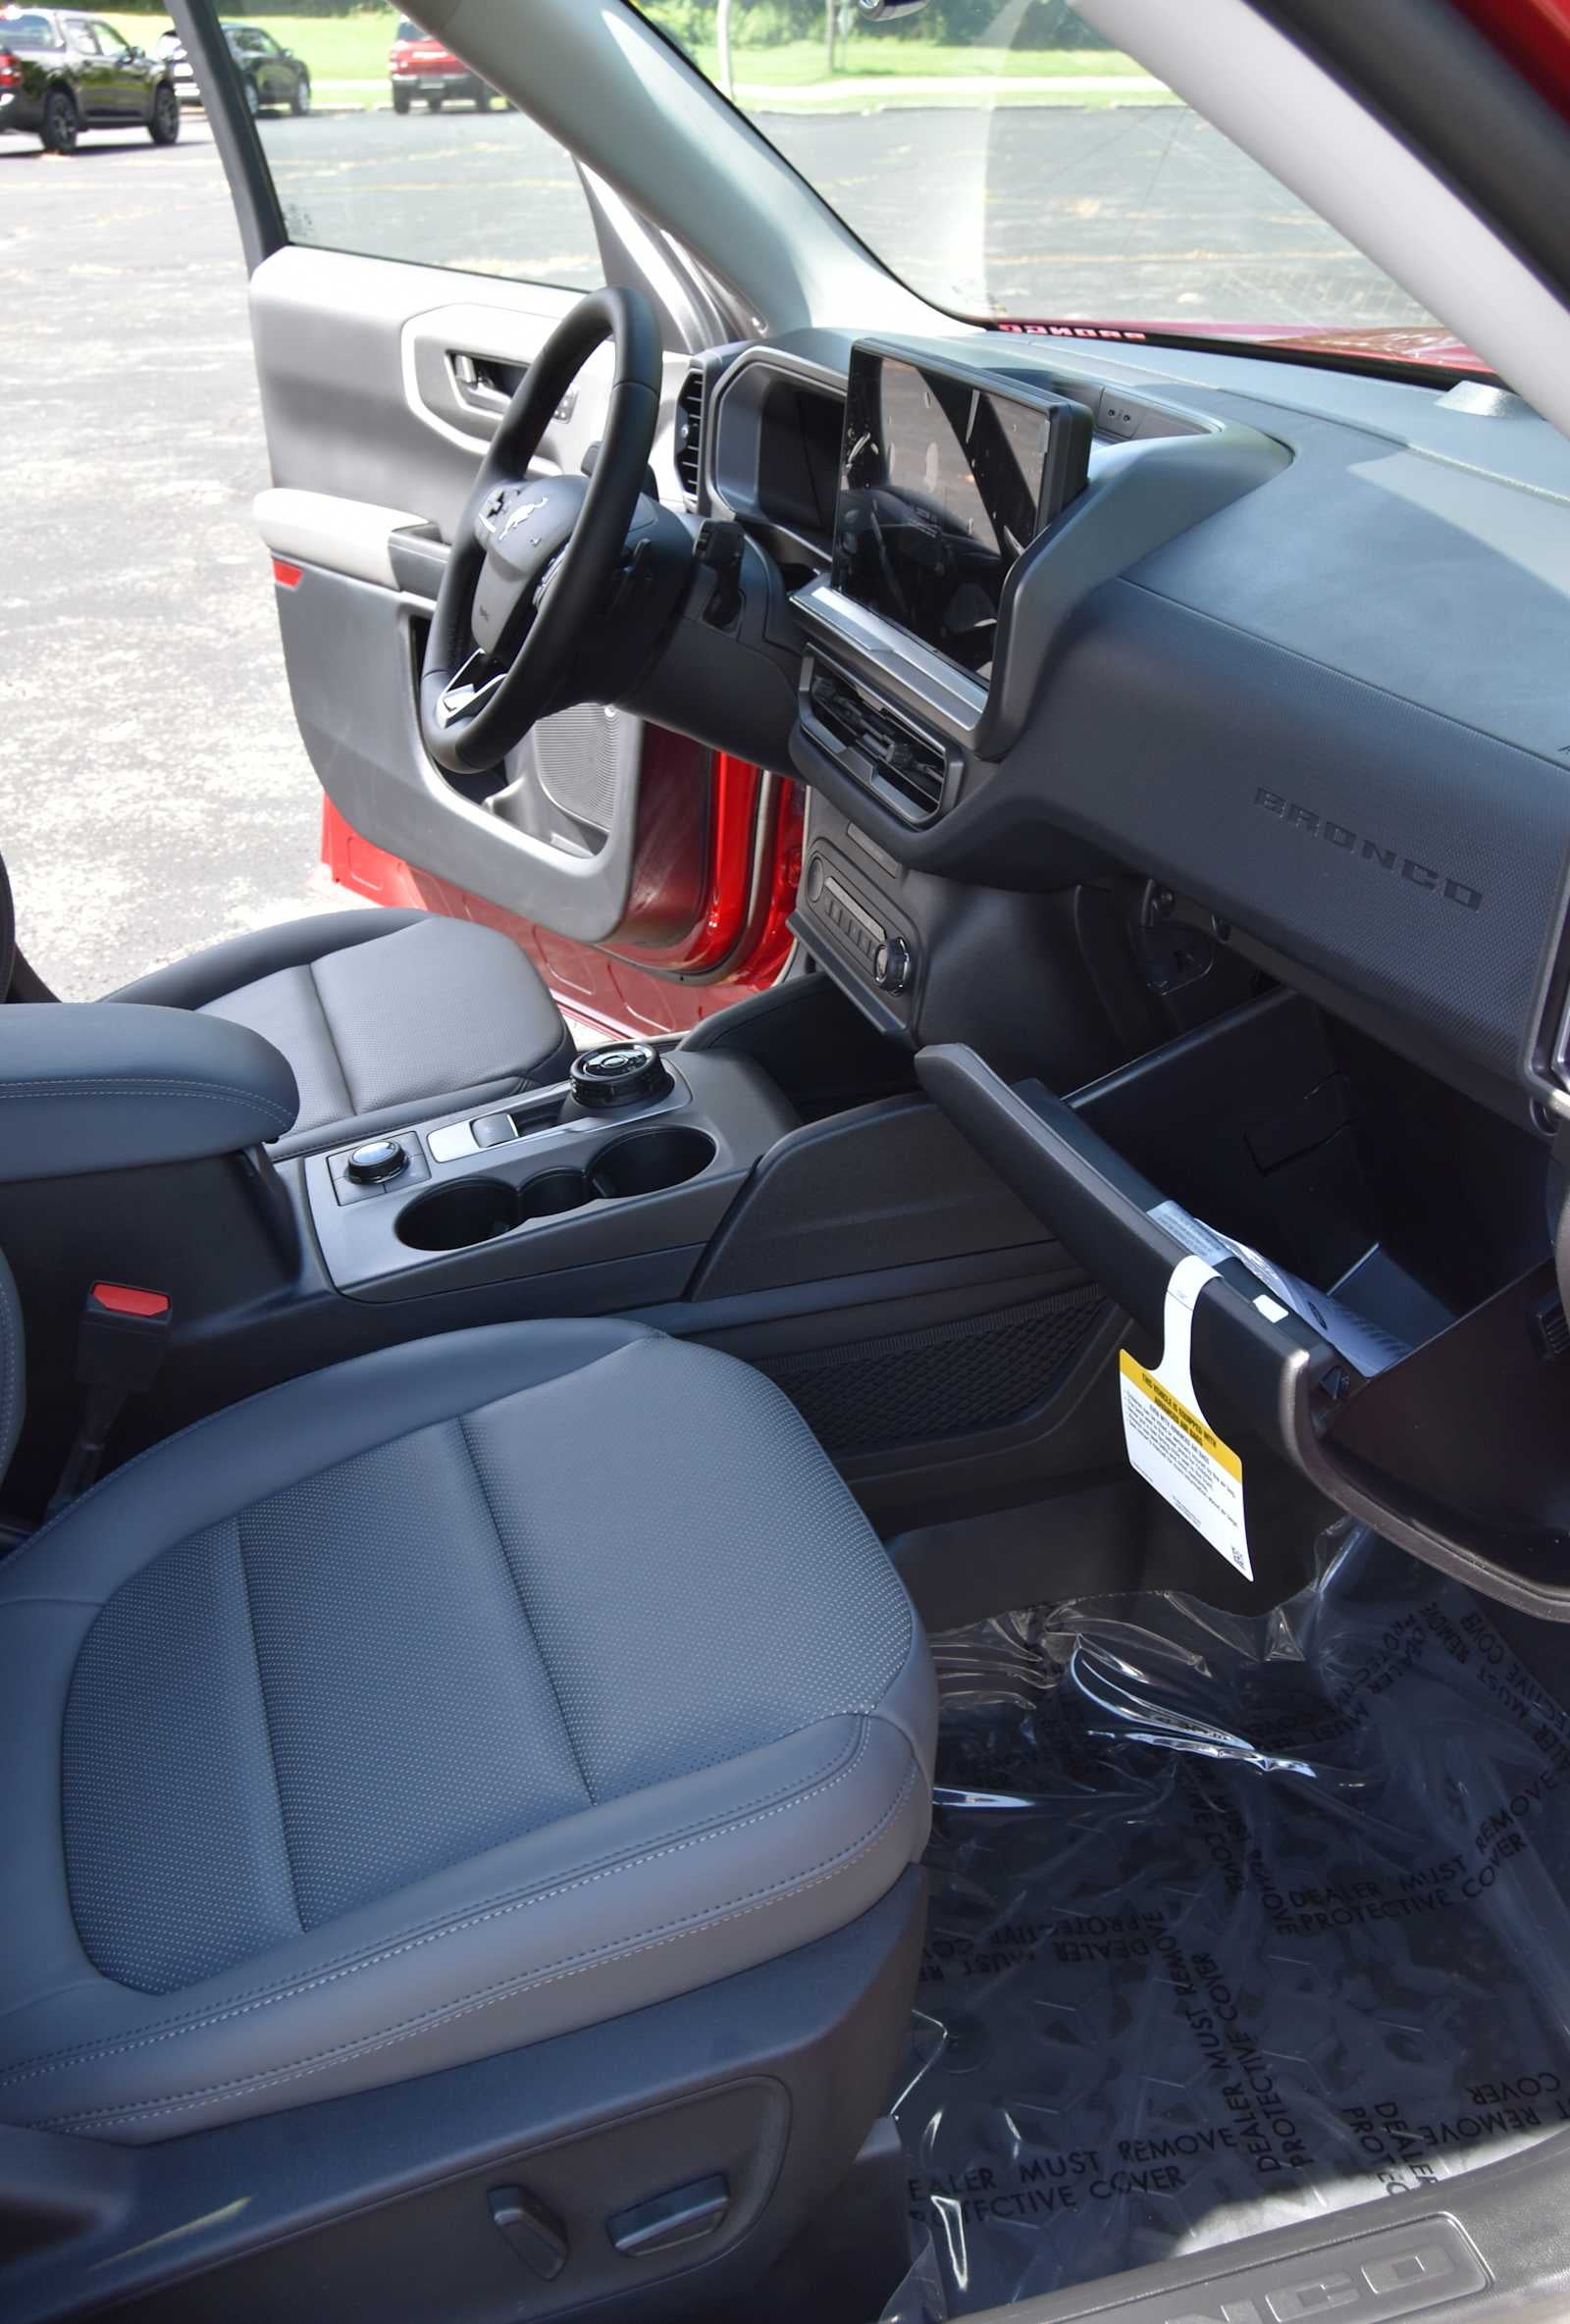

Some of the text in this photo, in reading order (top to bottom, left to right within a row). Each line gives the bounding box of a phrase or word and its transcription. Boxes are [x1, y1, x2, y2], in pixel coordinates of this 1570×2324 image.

[1254, 787, 1483, 911] BRONCO
[1477, 1667, 1530, 1720] MUST
[1288, 1770, 1559, 1909] DEALER MUST REMOVE
[1297, 1833, 1528, 1933] PROTECTIVE COVER
[1142, 1910, 1282, 2174] DEALER MUST REMOVE
[1190, 1951, 1316, 2169] PROTECTIVE COVER
[1417, 2105, 1542, 2148] REMOVE
[1465, 2071, 1561, 2106] COVER
[908, 2127, 1238, 2202] EALER MUST REMOVE
[1088, 2164, 1187, 2199] COVER
